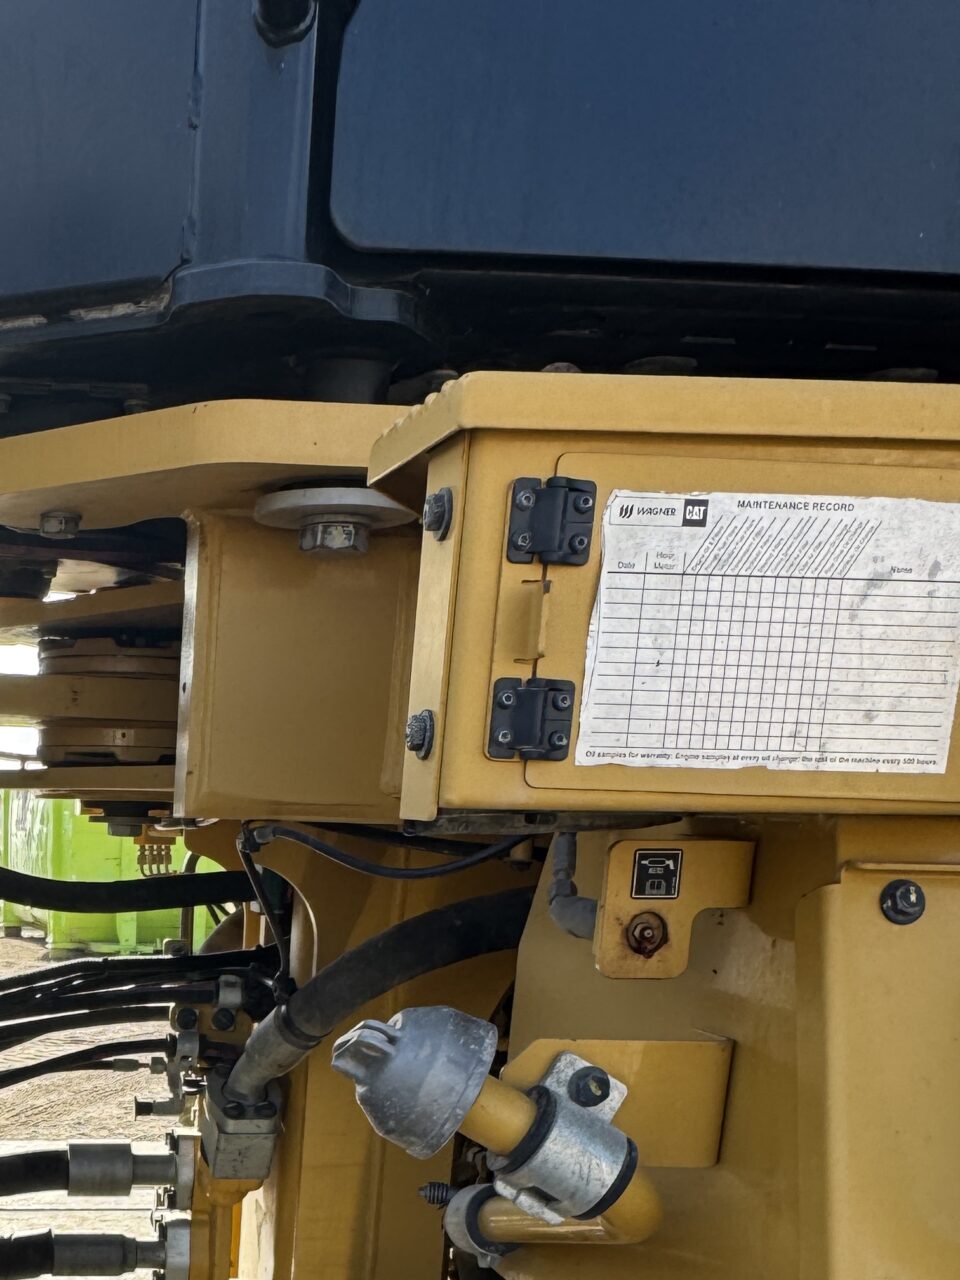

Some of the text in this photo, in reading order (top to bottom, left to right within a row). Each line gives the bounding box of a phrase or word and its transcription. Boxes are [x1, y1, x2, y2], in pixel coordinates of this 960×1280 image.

[637, 505, 706, 520] WAGNER CAT
[737, 499, 855, 512] MAINTENANCE RECORD
